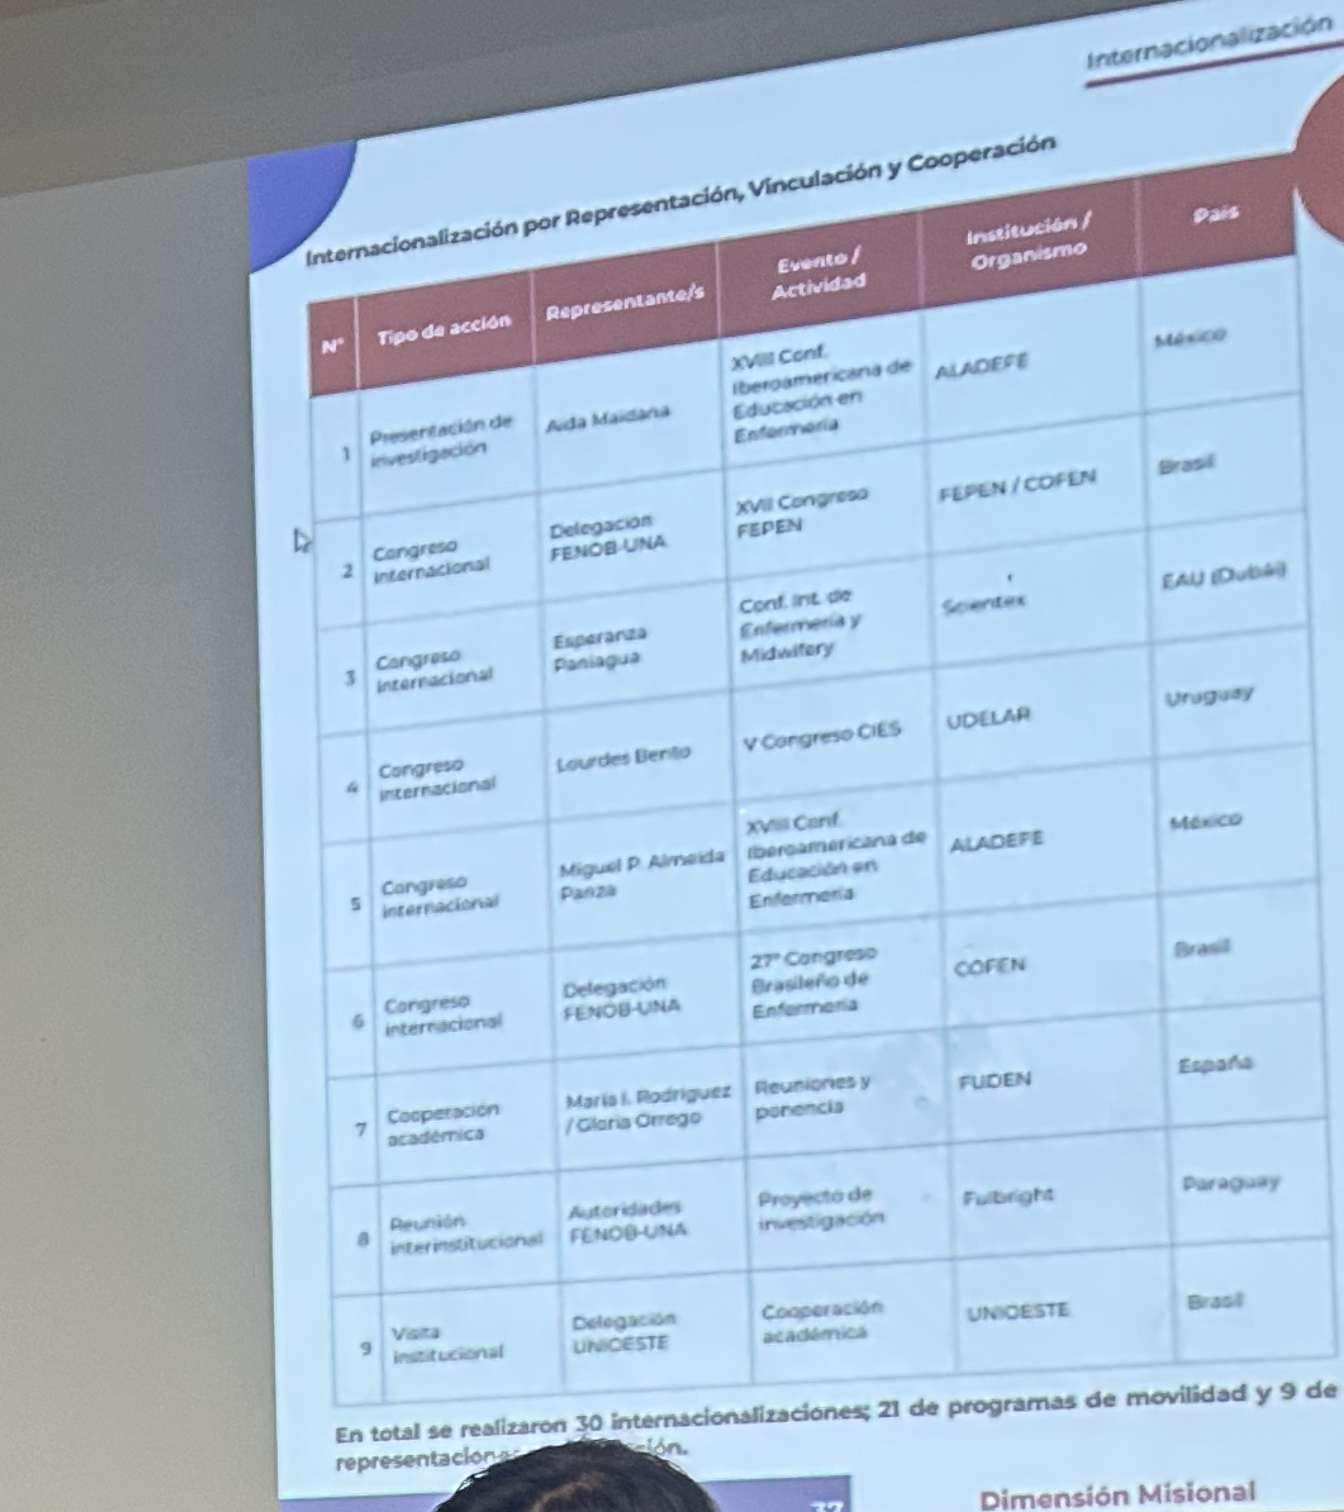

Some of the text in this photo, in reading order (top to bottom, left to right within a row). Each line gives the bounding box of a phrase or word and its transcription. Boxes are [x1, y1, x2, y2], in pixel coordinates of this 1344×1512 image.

[1087, 13, 1333, 72] Internacionalización
[307, 132, 1056, 267] Internacionalización por Representación, Vinculación y Cooperación
[966, 216, 1078, 246] Institución
[777, 252, 848, 275] Evento
[971, 239, 1088, 272] Organismo
[771, 271, 867, 301] Actividad
[546, 283, 705, 322] Representante/s
[378, 312, 511, 347] Tipo de acción
[1154, 326, 1228, 351] México
[732, 344, 828, 371] XVIII Conf.
[733, 357, 912, 395] Iberoamericana de
[733, 389, 863, 420] Educación en
[370, 414, 513, 446] Presentación de
[371, 441, 487, 468] investigación
[1158, 453, 1215, 477] Brasil
[939, 468, 1097, 504] FEPEN COFEN
[778, 486, 869, 512] Congreso
[737, 517, 802, 540] FEPEN
[373, 538, 458, 564] Congreso
[344, 563, 353, 579] 2
[1162, 570, 1205, 591] EAU
[739, 595, 789, 616] Conf.
[827, 587, 852, 604] de
[850, 612, 862, 631] y
[553, 626, 647, 652] Esperanza
[376, 647, 461, 673] Congreso
[554, 650, 640, 673] Paniagua
[346, 671, 355, 686] 3
[1165, 685, 1254, 709] Uruguay
[946, 707, 1031, 731] UDELAR
[744, 720, 902, 753] V Congreso CIES
[379, 757, 464, 781] Congreso
[557, 751, 630, 774] Lourdes
[347, 781, 358, 795] 4
[1170, 810, 1243, 831] México
[747, 827, 928, 860] Iberoamericana de
[950, 829, 1044, 854] ALADEFE
[559, 848, 726, 880] Miguel Almeida
[748, 857, 878, 885] Educación en
[382, 874, 467, 898] Congreso
[561, 882, 617, 903] Panza
[350, 898, 361, 912] 5
[785, 944, 878, 970] Congreso
[1174, 938, 1232, 959] Brasil
[844, 968, 869, 987] de
[954, 956, 1026, 978] COFEN
[563, 975, 667, 1000] Delegación
[384, 994, 470, 1016] Congreso
[564, 997, 682, 1022] FENOB-UNA
[352, 1014, 364, 1029] 6
[1178, 1053, 1254, 1076] España
[755, 1073, 857, 1096] Reuniones
[959, 1069, 1032, 1091] FUDEN
[387, 1101, 500, 1128] Cooperación
[577, 1109, 702, 1134] Gloria Orrego
[755, 1097, 844, 1122] ponencia
[356, 1123, 367, 1137] 7
[387, 1123, 485, 1148] académica
[1182, 1173, 1281, 1195] Paraguay
[758, 1186, 873, 1211] Proyecto de
[964, 1187, 1054, 1211] Fulbright
[390, 1213, 465, 1232] Reunión
[567, 1200, 682, 1223] Autoridades
[759, 1209, 886, 1234] investigación
[357, 1231, 369, 1246] 8
[569, 1221, 687, 1245] FENOB-UNA
[761, 1300, 883, 1322] Cooperación
[1187, 1290, 1244, 1310] Brasil
[572, 1312, 677, 1333] Delegación
[967, 1302, 1069, 1323] UNIOESTE
[392, 1324, 441, 1341] Visita
[763, 1323, 868, 1345] académica
[360, 1341, 372, 1356] 9
[335, 1426, 363, 1443] En
[371, 1422, 420, 1441] total
[429, 1425, 452, 1439] se
[460, 1416, 566, 1438] realizaron
[576, 1414, 602, 1431] 30
[877, 1400, 900, 1418] 21
[909, 1397, 938, 1417] de
[948, 1391, 1077, 1419] programas
[1085, 1390, 1116, 1409] de
[1126, 1383, 1247, 1407] movilidad
[1255, 1386, 1271, 1407] y
[1281, 1383, 1295, 1400] 9
[1305, 1380, 1338, 1400] de
[980, 1481, 1257, 1512] Dimensión Misional
